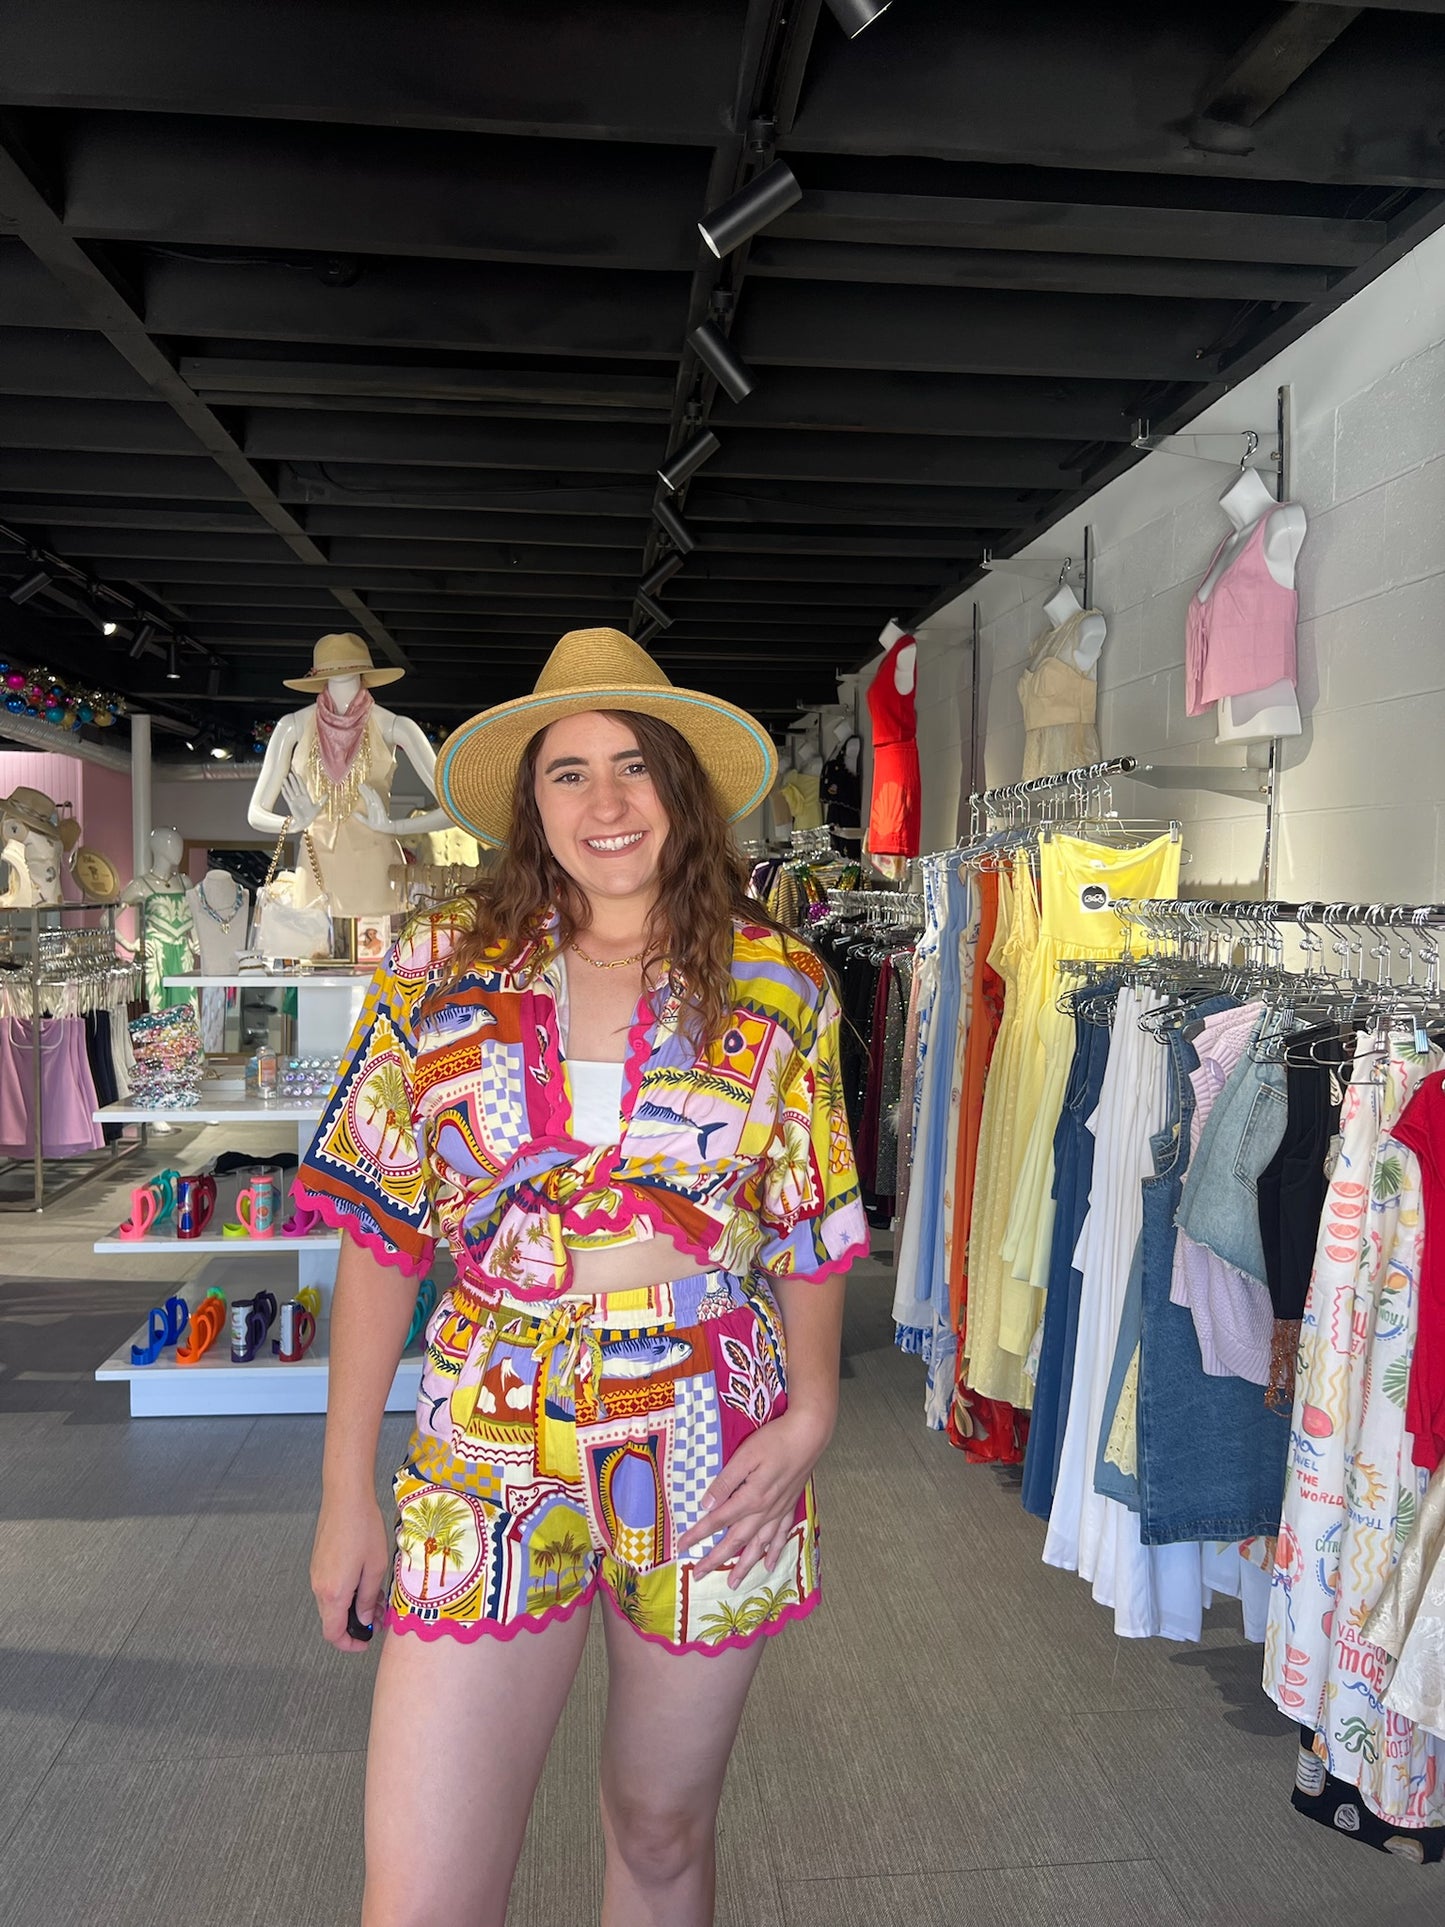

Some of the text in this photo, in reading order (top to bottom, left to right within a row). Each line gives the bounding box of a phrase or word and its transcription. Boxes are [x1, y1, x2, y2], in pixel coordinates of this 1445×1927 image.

[1296, 1469, 1319, 1487] THE
[1300, 1487, 1343, 1506] WORLD
[1315, 1537, 1341, 1553] CITR
